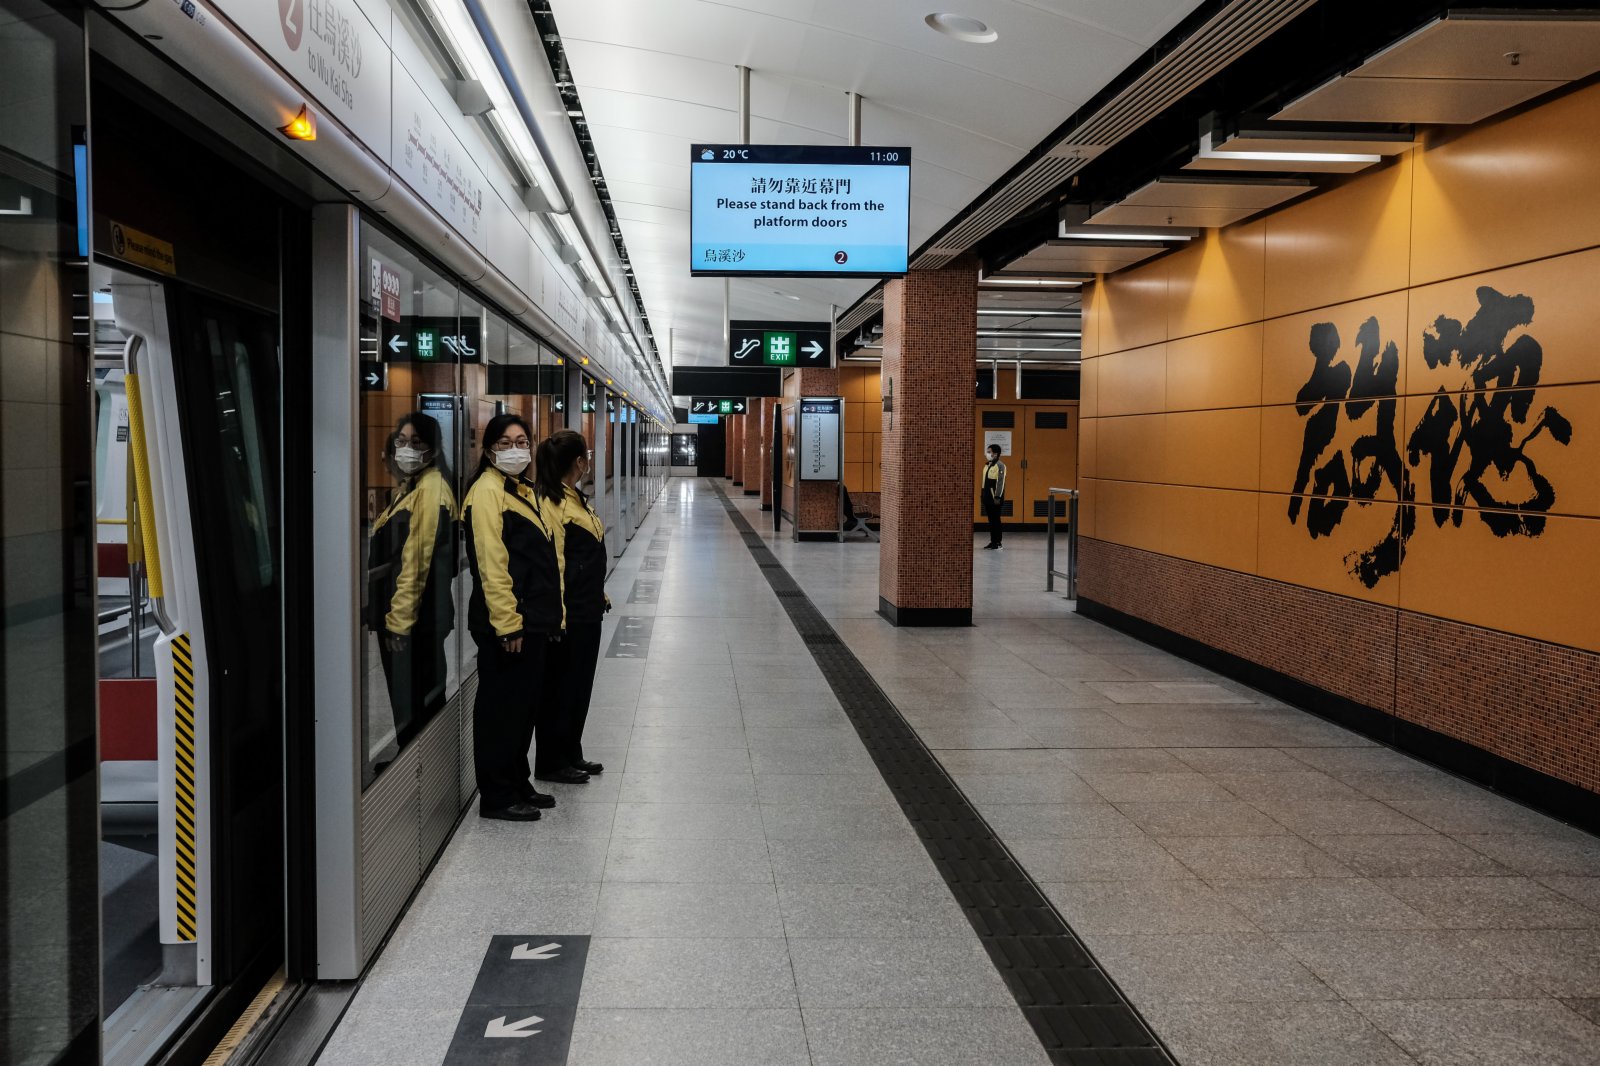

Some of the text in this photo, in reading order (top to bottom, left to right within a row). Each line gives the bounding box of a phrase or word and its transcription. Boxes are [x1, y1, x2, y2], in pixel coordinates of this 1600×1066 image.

[307, 46, 353, 110] to Wu Kai Sha
[722, 149, 736, 159] 20
[870, 151, 899, 162] 11:00
[750, 176, 852, 195] 請勿靠近幕門
[716, 198, 885, 211] Please stand back from the
[753, 216, 848, 229] platform doors
[703, 248, 747, 263] 烏溪沙
[770, 336, 790, 354] 出
[770, 353, 790, 361] EXIT
